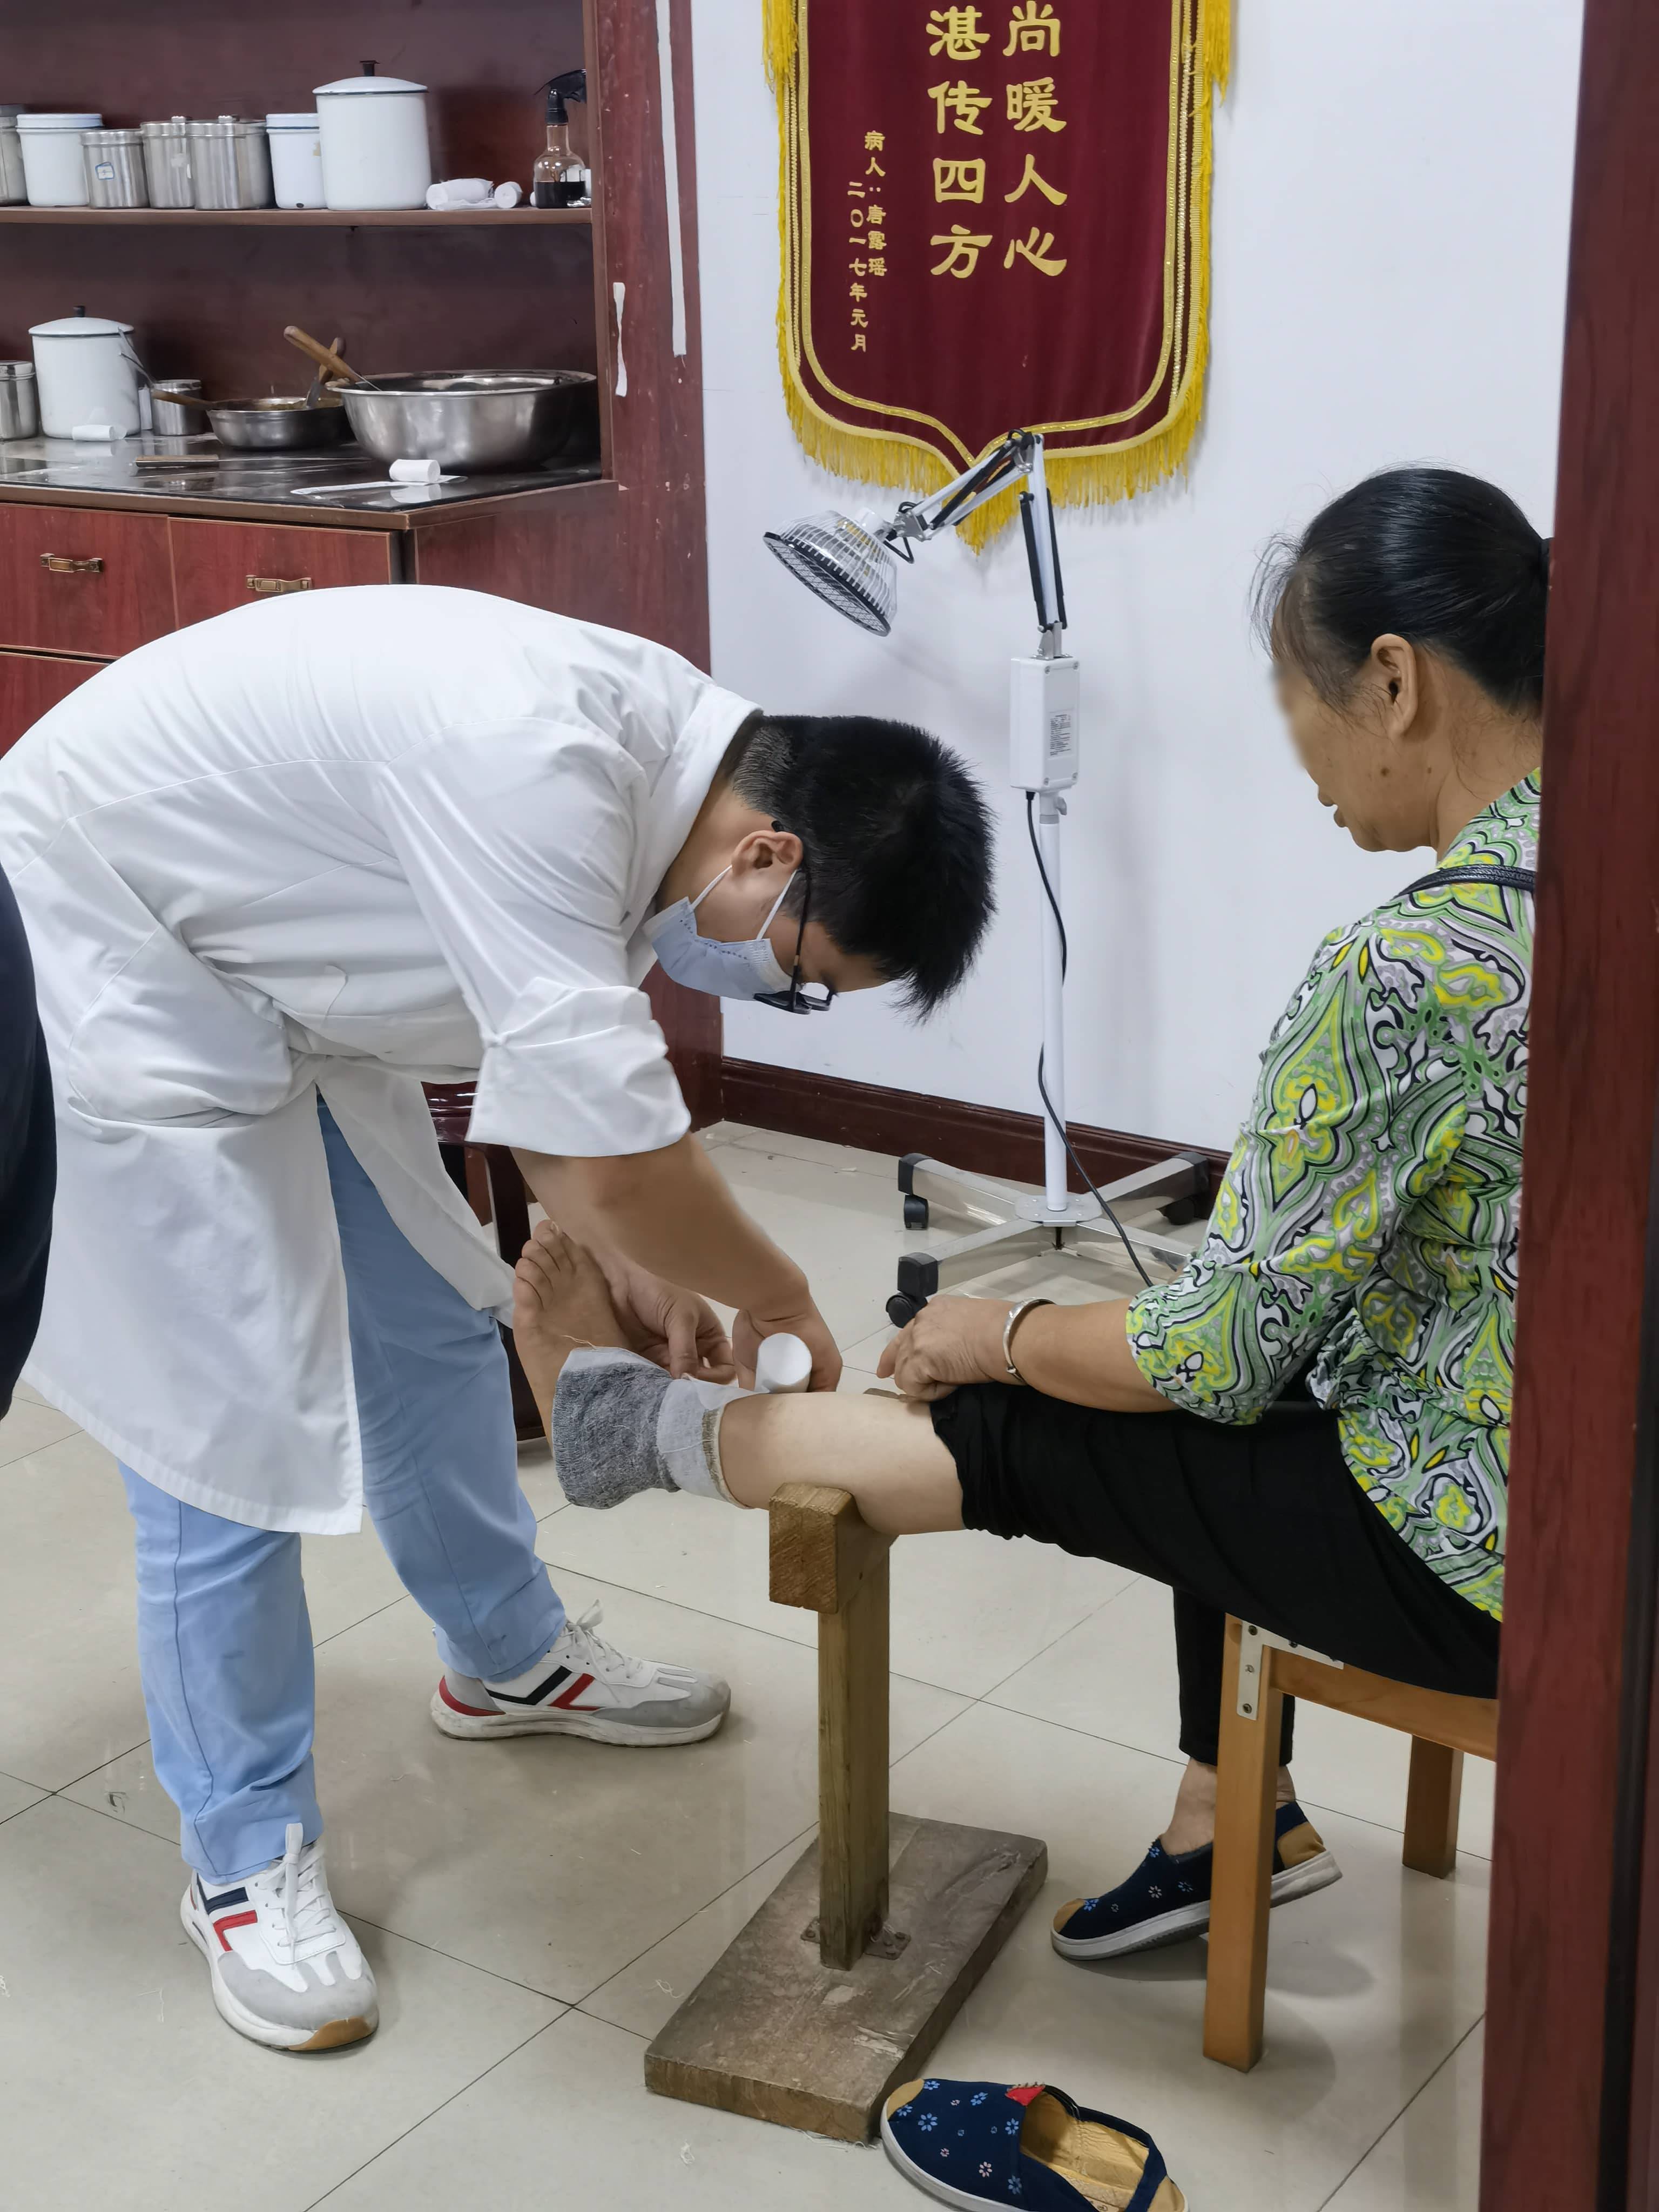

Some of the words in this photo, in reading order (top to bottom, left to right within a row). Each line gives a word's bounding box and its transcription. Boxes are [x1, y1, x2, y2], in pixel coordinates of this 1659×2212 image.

[926, 5, 993, 279] 湛传四方
[1002, 0, 1068, 276] 尚暖人心
